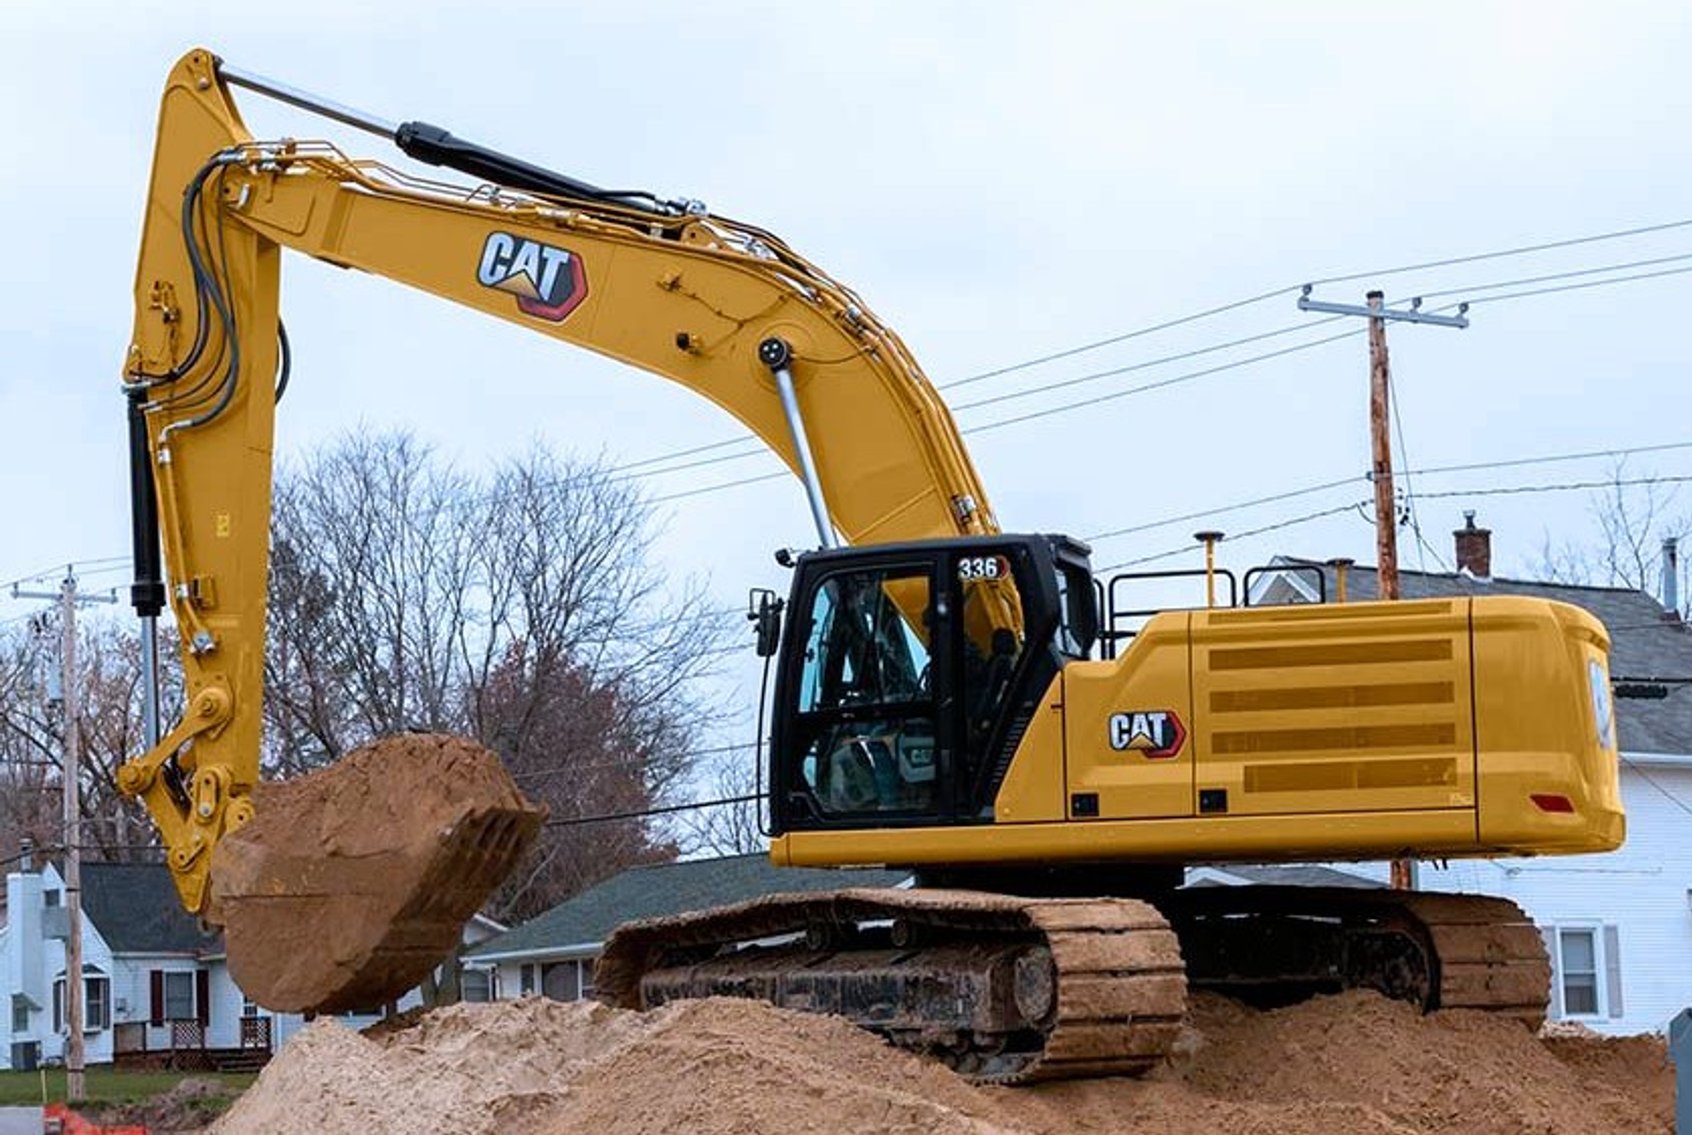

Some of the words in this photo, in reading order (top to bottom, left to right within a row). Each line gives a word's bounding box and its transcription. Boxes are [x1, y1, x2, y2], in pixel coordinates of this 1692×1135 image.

[478, 232, 570, 301] CAT
[959, 557, 997, 578] 336
[1110, 712, 1167, 749] CAT
